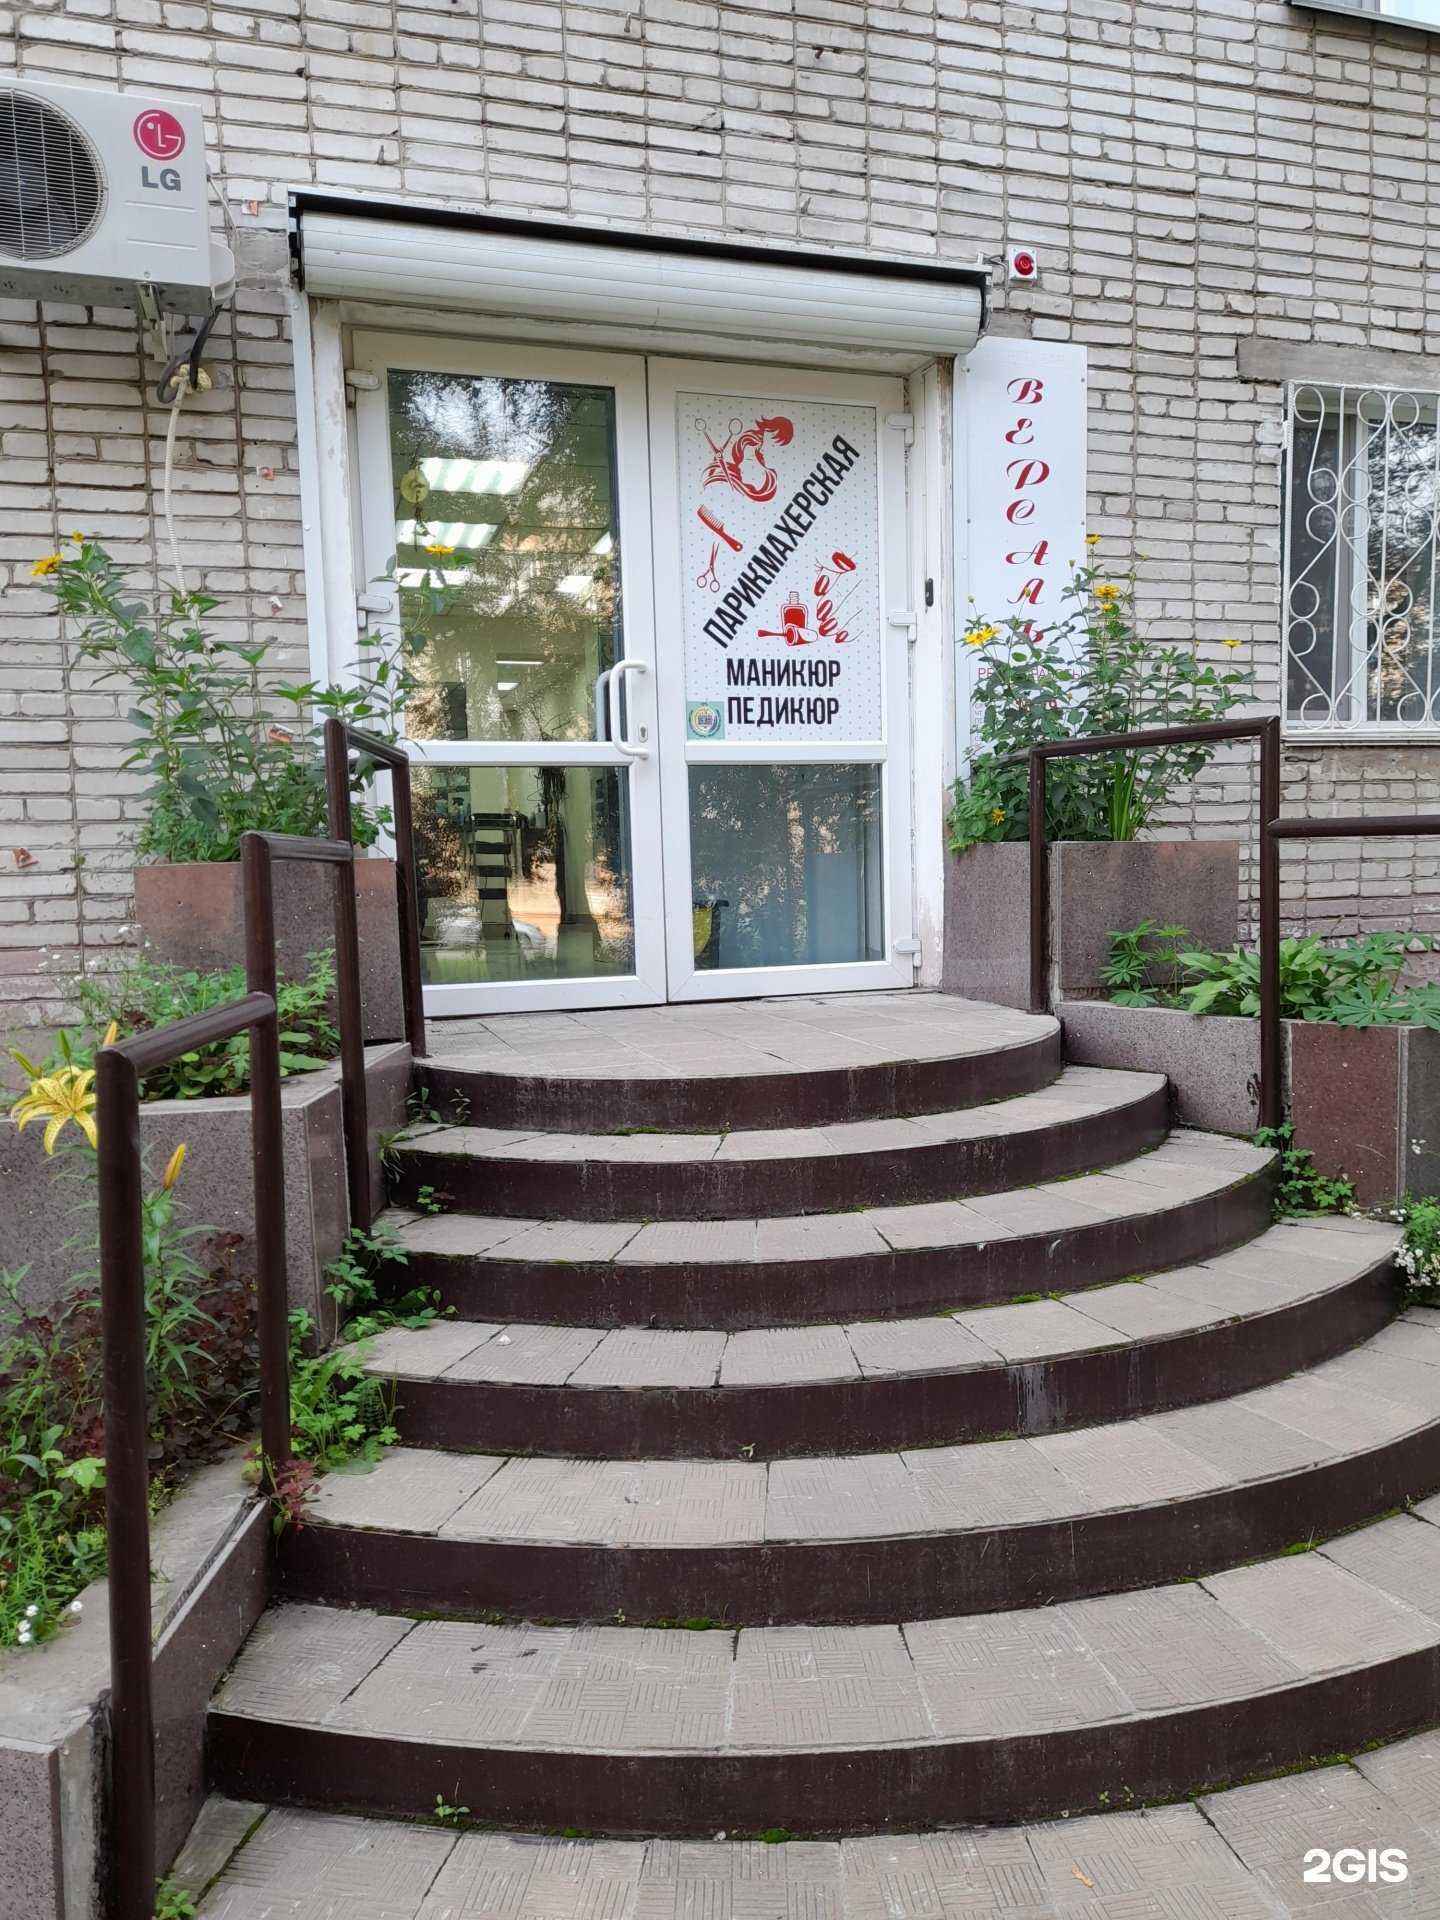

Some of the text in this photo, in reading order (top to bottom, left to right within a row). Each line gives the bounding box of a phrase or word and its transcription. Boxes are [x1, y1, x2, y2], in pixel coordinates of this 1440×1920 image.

[141, 165, 182, 192] LG
[702, 434, 861, 649] ПАРИКМАХЕРСКАЯ
[726, 658, 841, 687] МАНИКЮР
[727, 696, 840, 728] ПЕДИКЮР
